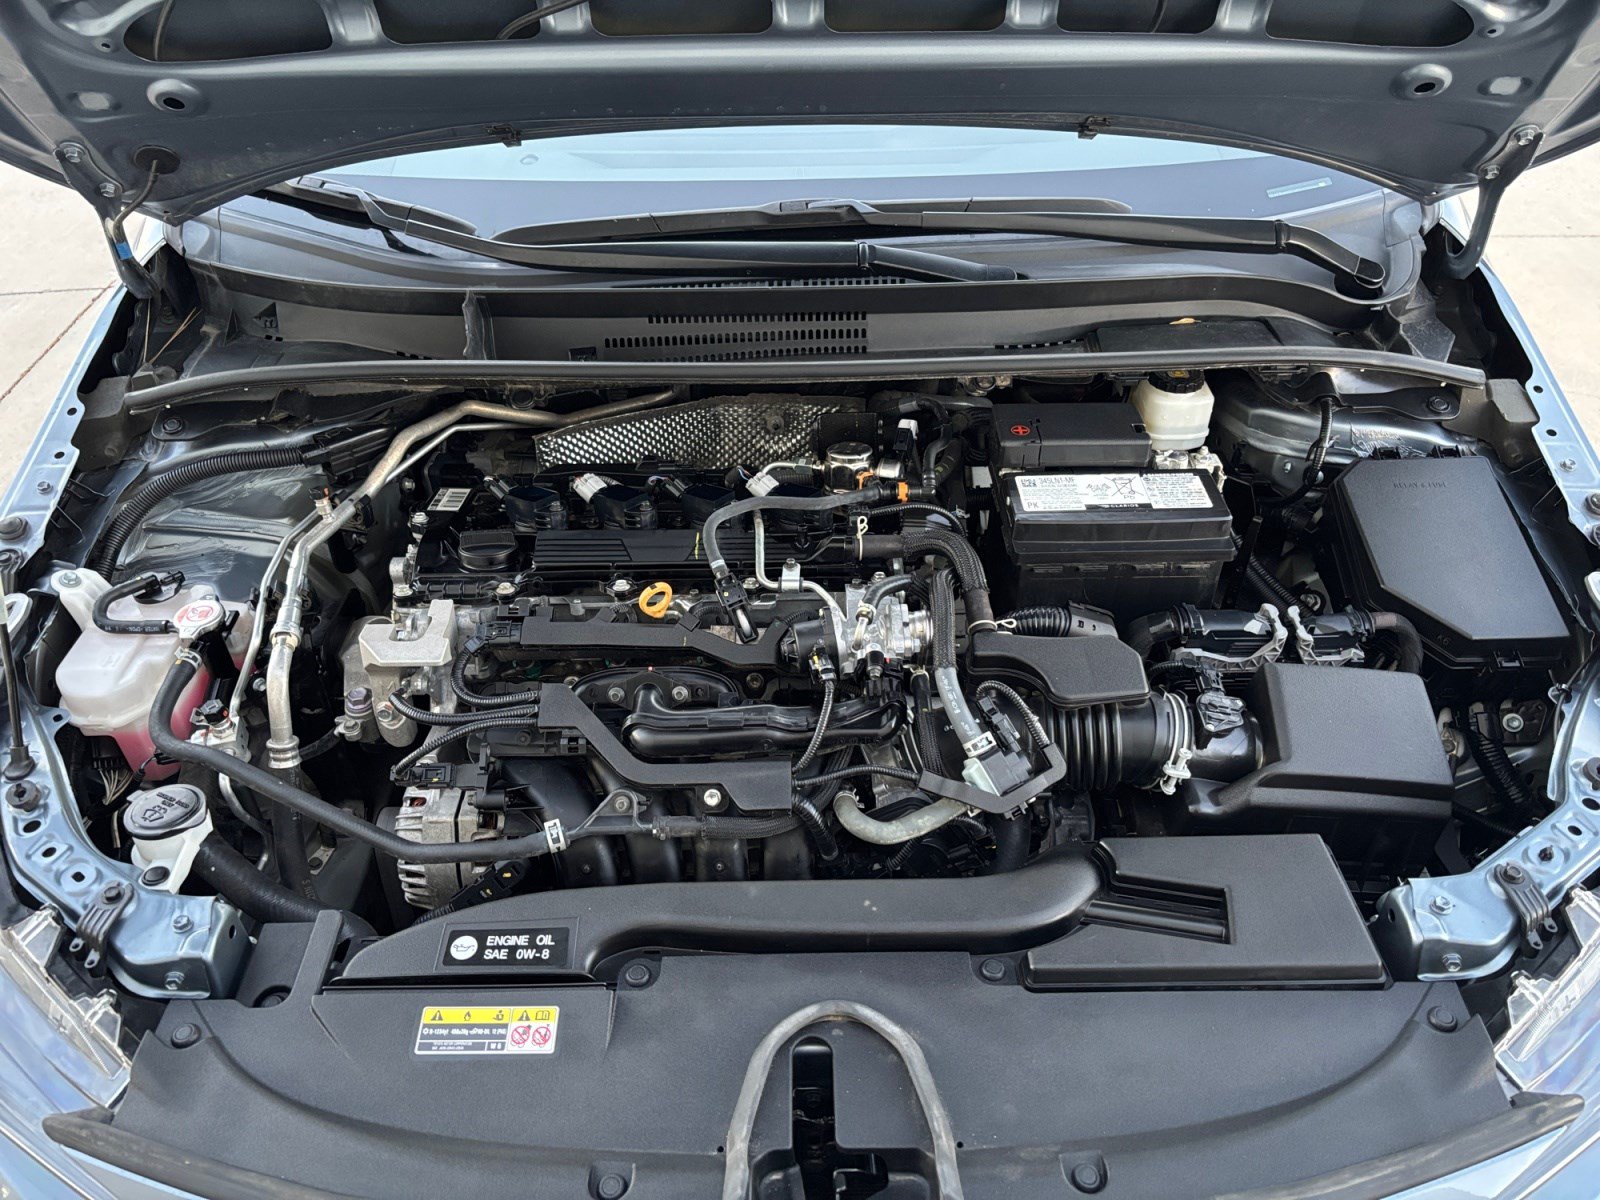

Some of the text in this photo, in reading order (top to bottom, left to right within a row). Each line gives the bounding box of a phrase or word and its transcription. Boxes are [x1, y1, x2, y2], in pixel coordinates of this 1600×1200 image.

[486, 934, 555, 946] ENGINE OIL
[483, 949, 550, 959] SAE 0W-8
